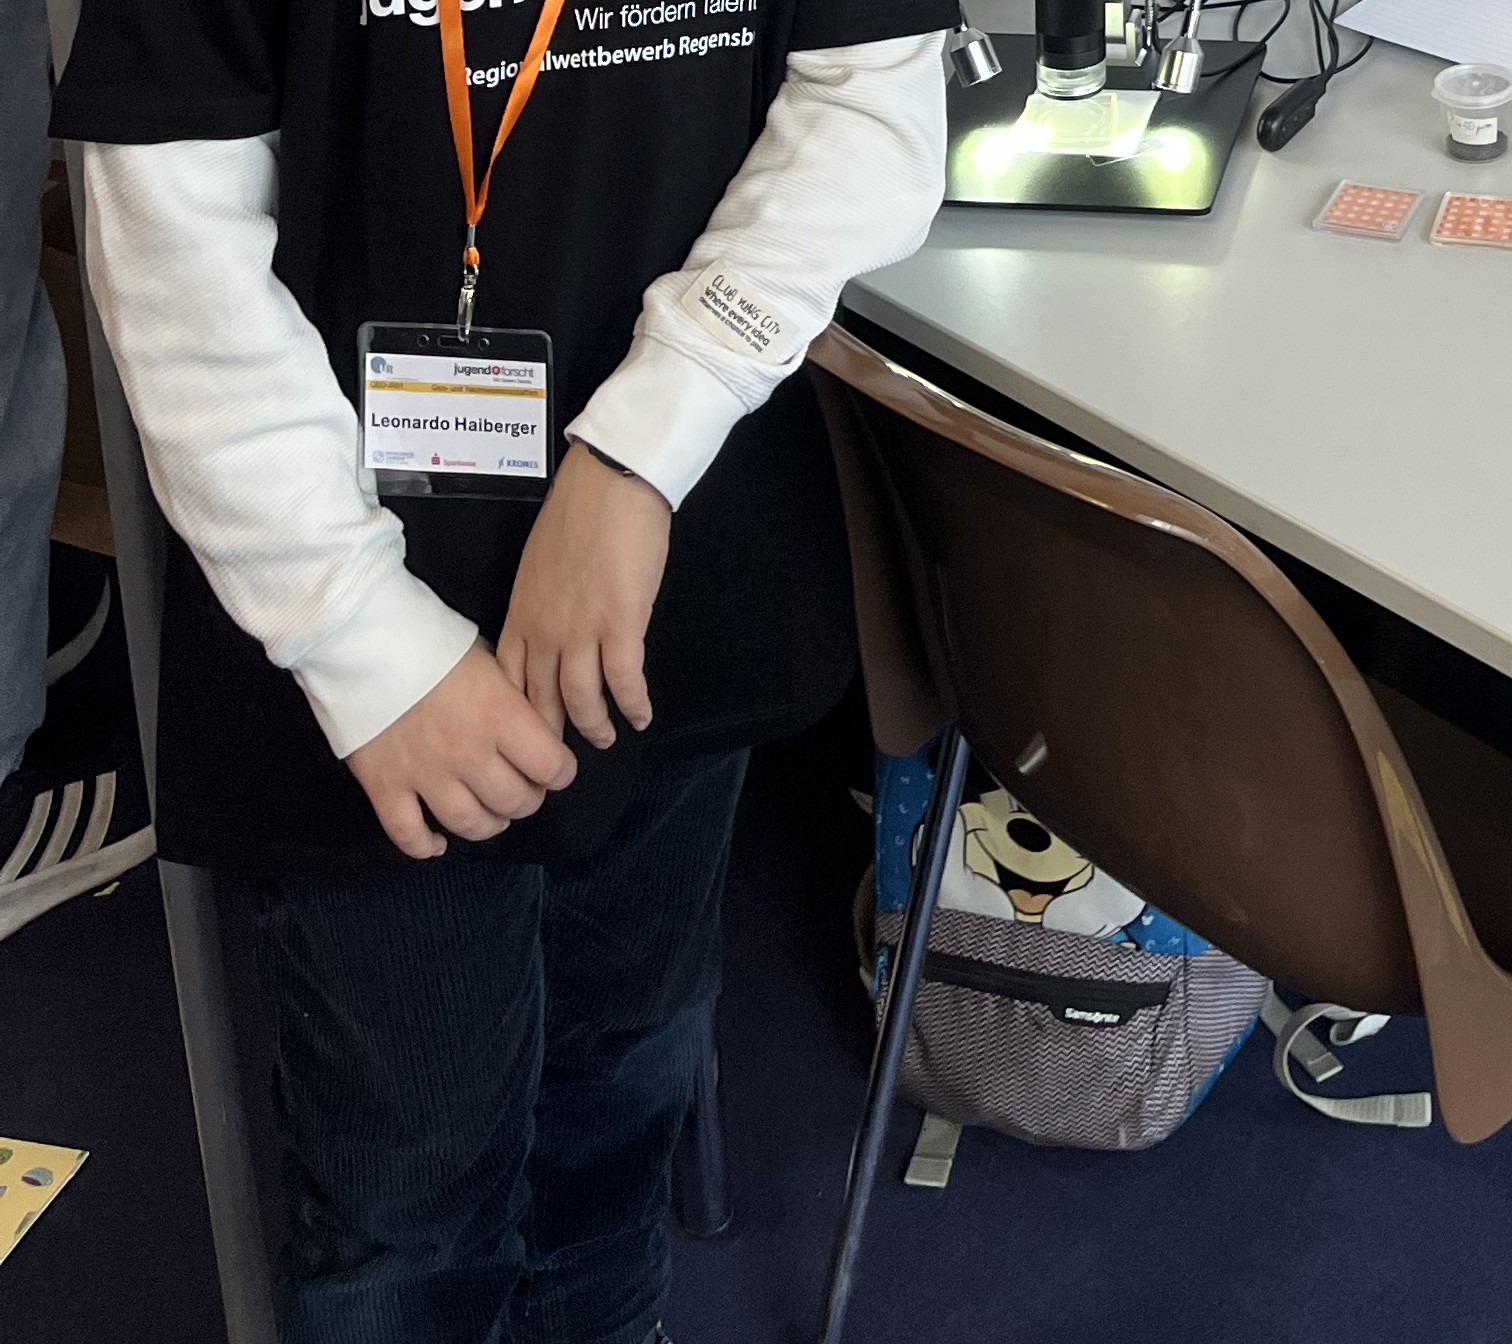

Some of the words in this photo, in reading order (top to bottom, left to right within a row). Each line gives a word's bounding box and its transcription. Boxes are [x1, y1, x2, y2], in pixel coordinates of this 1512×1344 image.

[574, 8, 612, 31] Wir
[620, 0, 696, 28] fördern
[712, 274, 738, 302] CLUB
[728, 310, 753, 331] every
[453, 363, 491, 376] jugend
[371, 413, 450, 431] Leonardo
[455, 417, 537, 438] Haiberger
